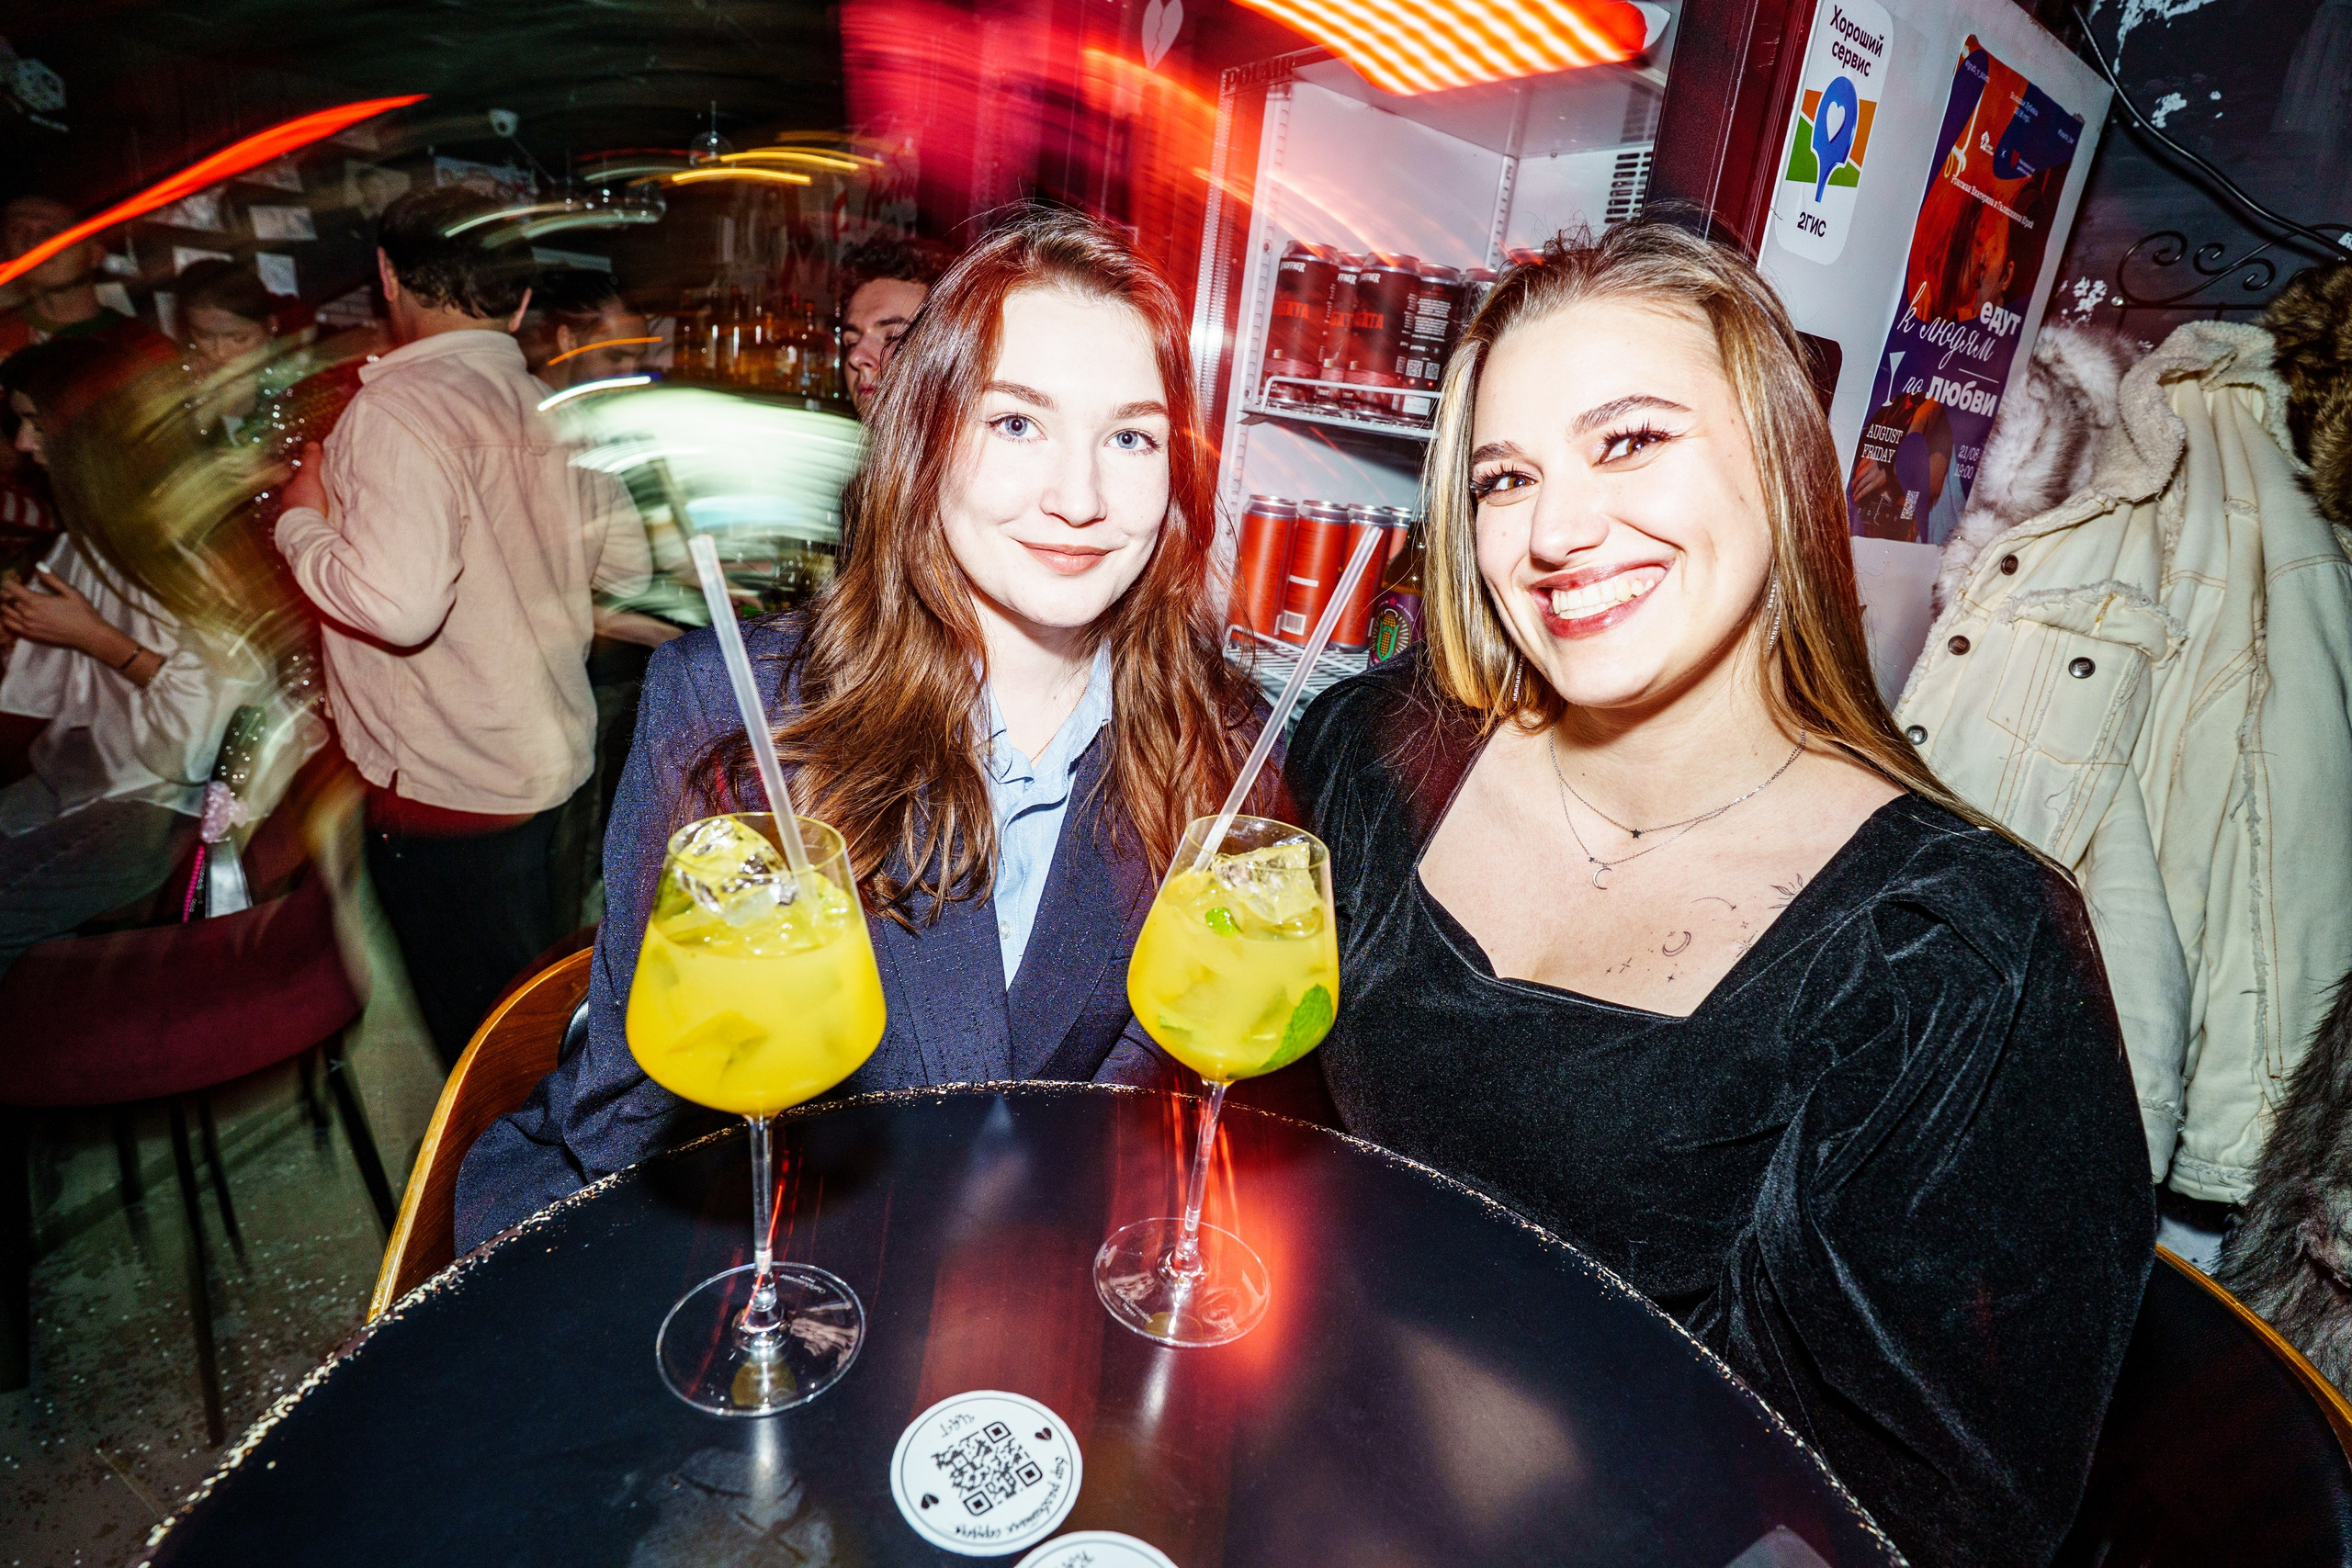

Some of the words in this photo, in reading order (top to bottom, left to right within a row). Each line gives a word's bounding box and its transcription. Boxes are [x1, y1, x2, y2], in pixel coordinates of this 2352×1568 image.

[1830, 5, 1884, 57] Хороший
[1224, 55, 1295, 91] POLAIR
[1832, 41, 1871, 76] сервис
[1797, 211, 1826, 237] 2ГИС
[1897, 281, 1927, 333] к
[1919, 317, 1996, 370] людям
[1980, 301, 2021, 337] едут
[1902, 376, 1924, 396] по
[1925, 376, 1997, 417] любви
[1866, 423, 1904, 444] AUGUST
[1860, 444, 1895, 463] FRIDAY
[1954, 463, 1974, 479] 19:00
